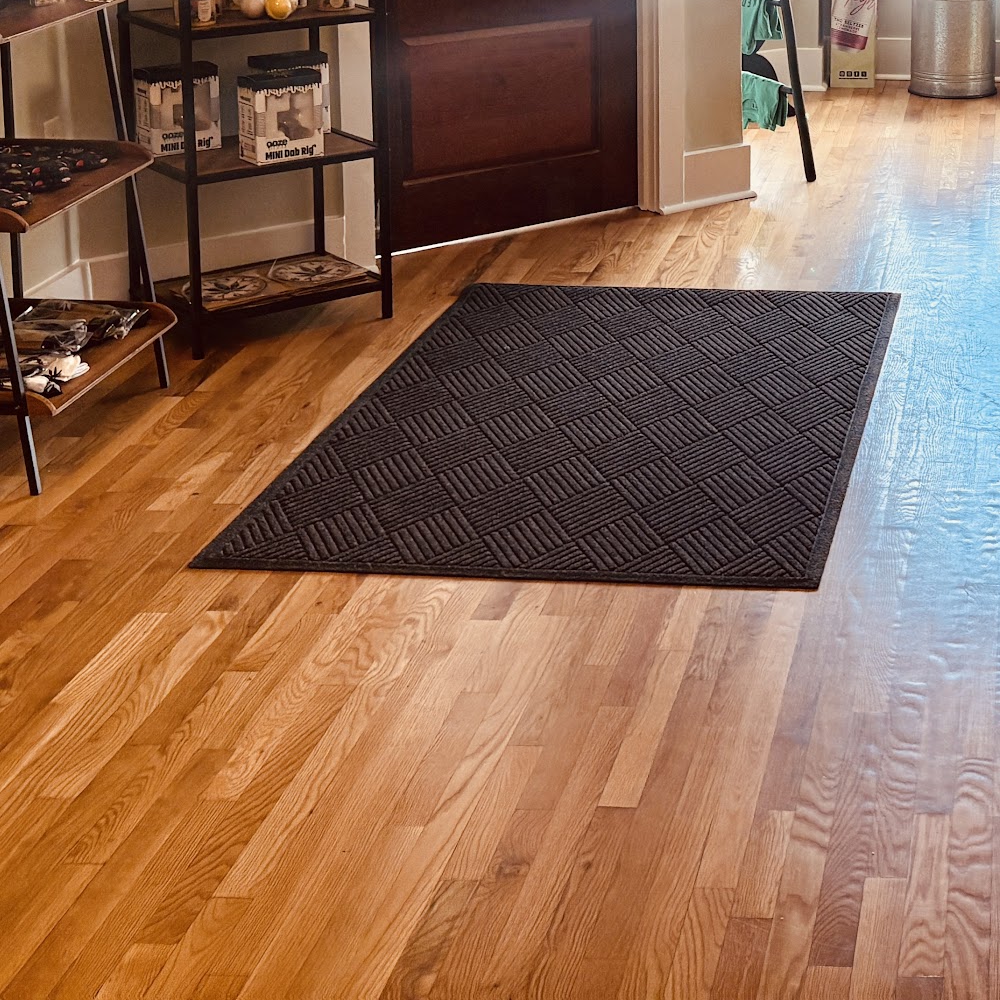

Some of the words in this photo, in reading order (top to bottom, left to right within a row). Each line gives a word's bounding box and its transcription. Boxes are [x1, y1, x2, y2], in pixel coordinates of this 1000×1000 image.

[161, 142, 180, 153] MINI
[198, 136, 214, 149] Rig
[265, 152, 283, 161] MINI
[285, 148, 300, 158] Dab
[301, 145, 316, 157] Rig
